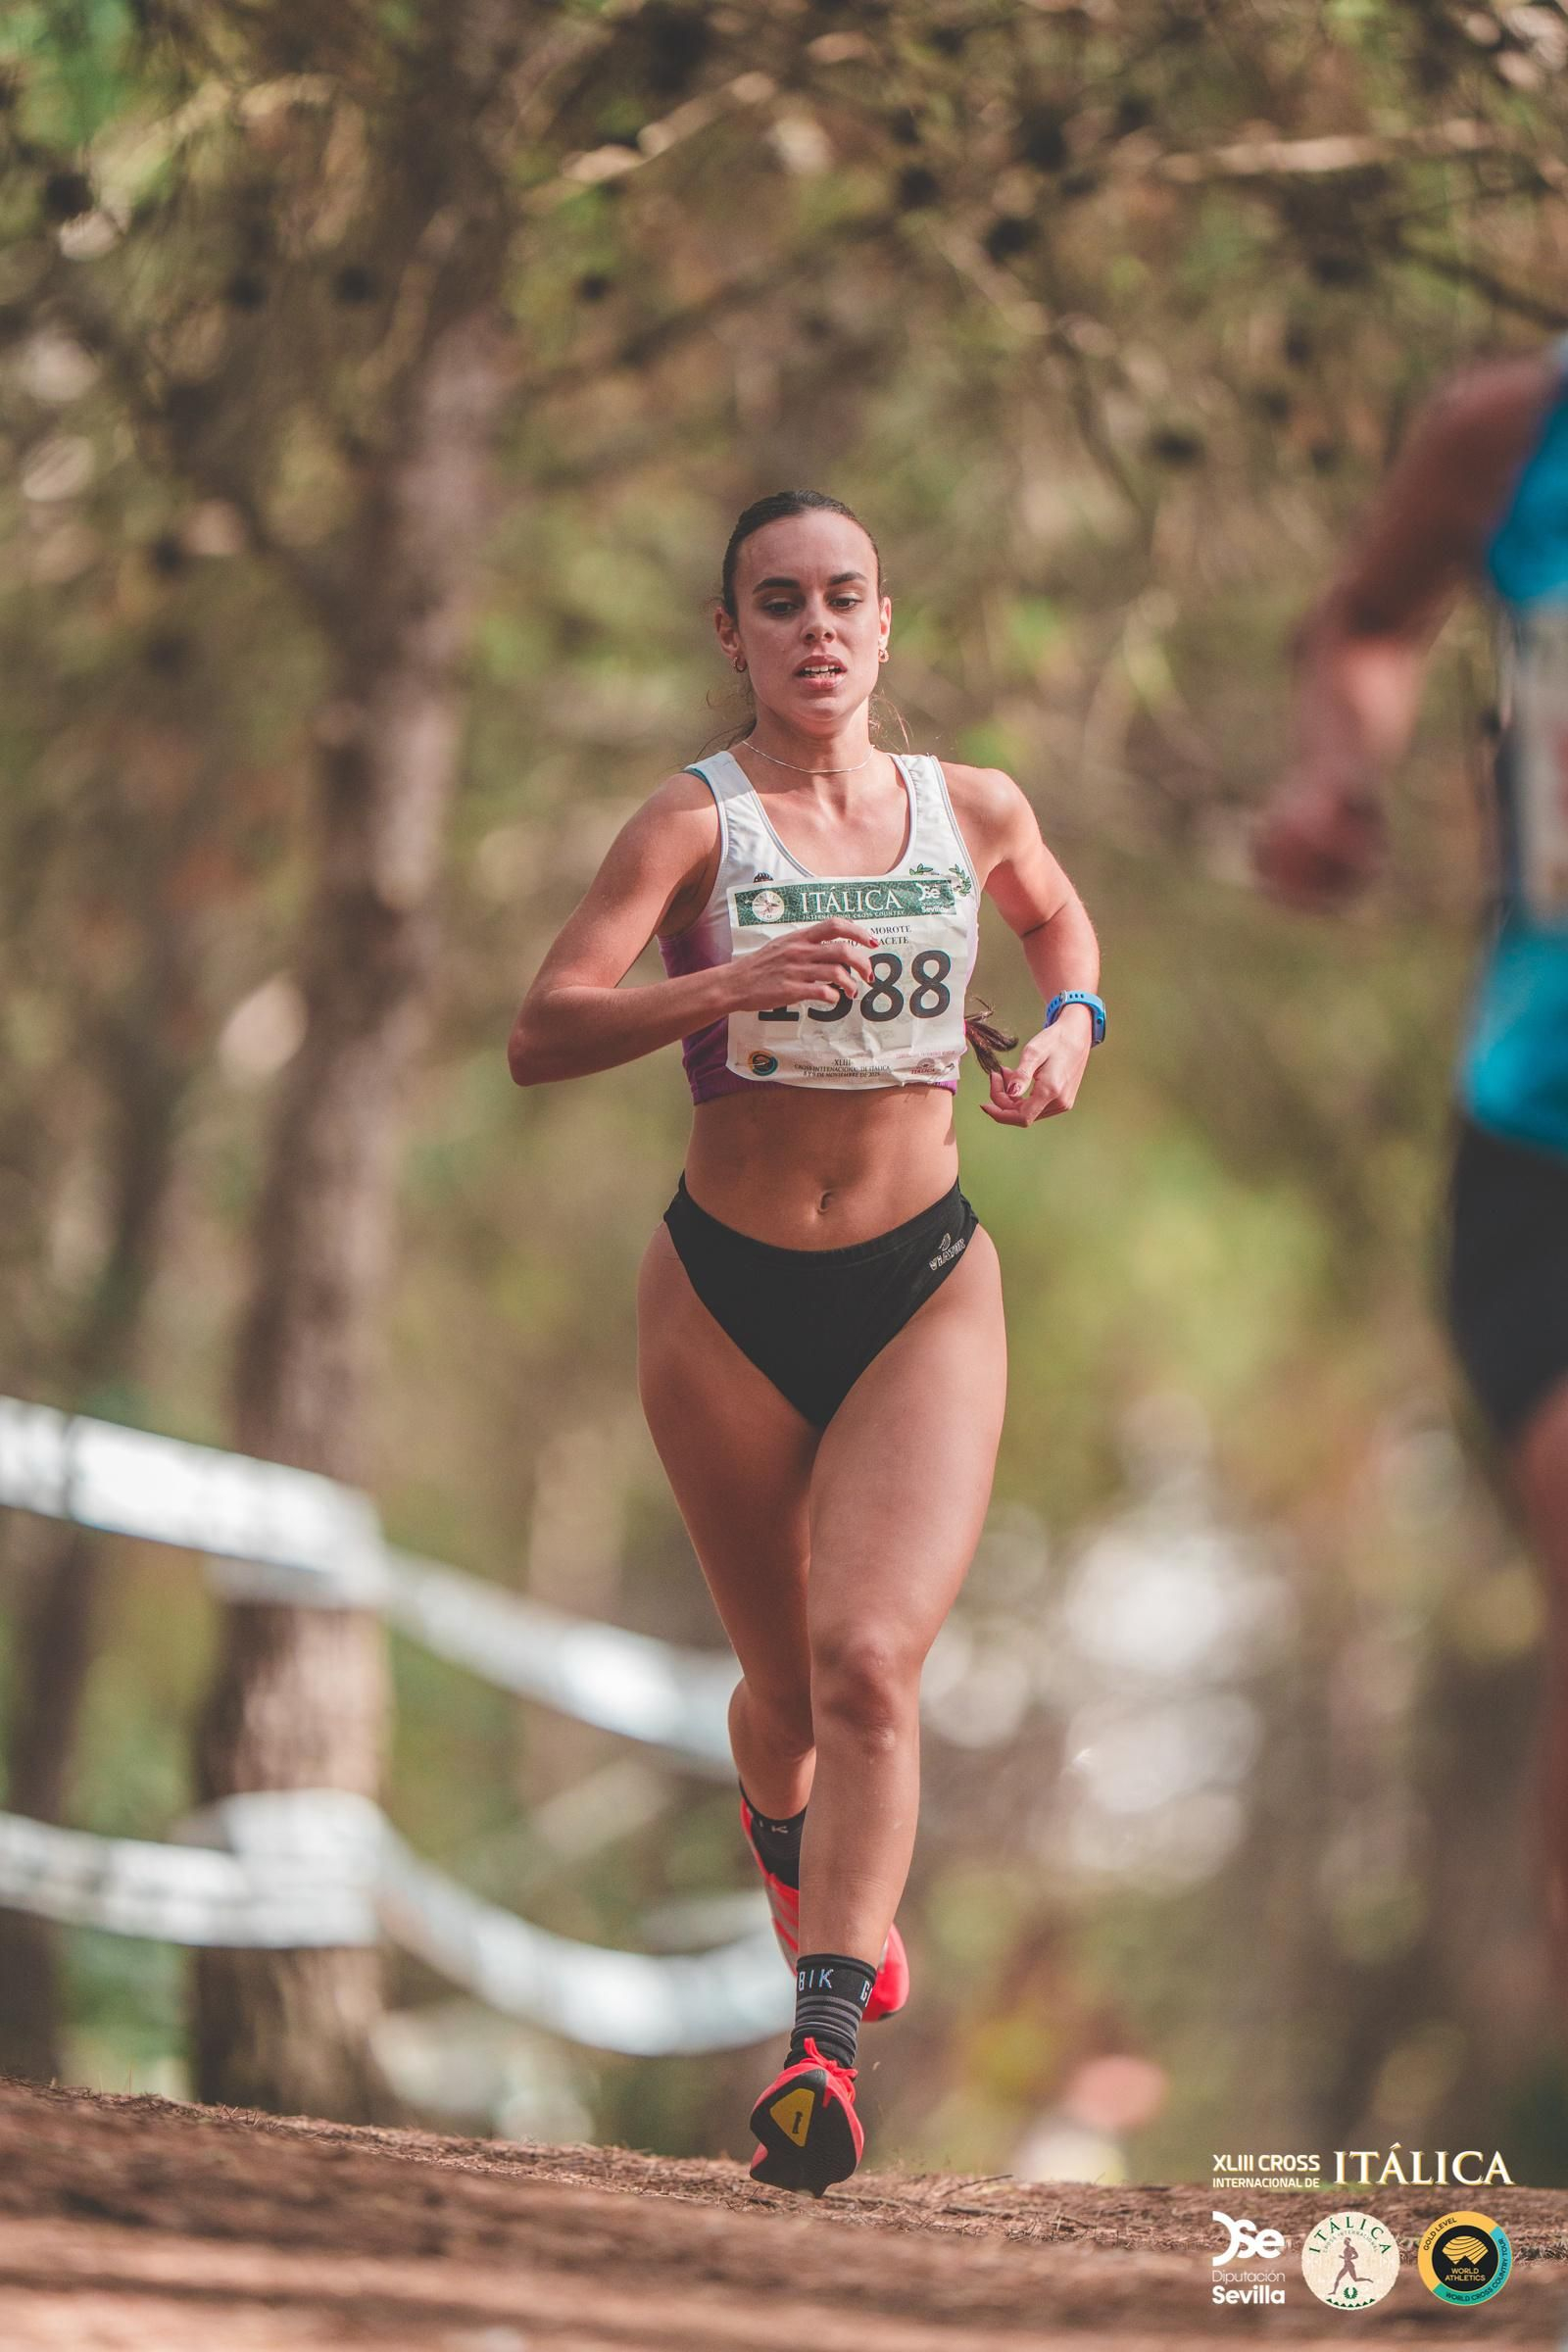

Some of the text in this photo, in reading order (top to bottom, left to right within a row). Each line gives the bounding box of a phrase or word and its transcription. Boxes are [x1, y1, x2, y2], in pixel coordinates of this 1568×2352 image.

[801, 886, 904, 913] ITÁLICA
[871, 925, 911, 934] MOROTE
[879, 936, 908, 946] ACETE
[759, 950, 952, 1022] 388
